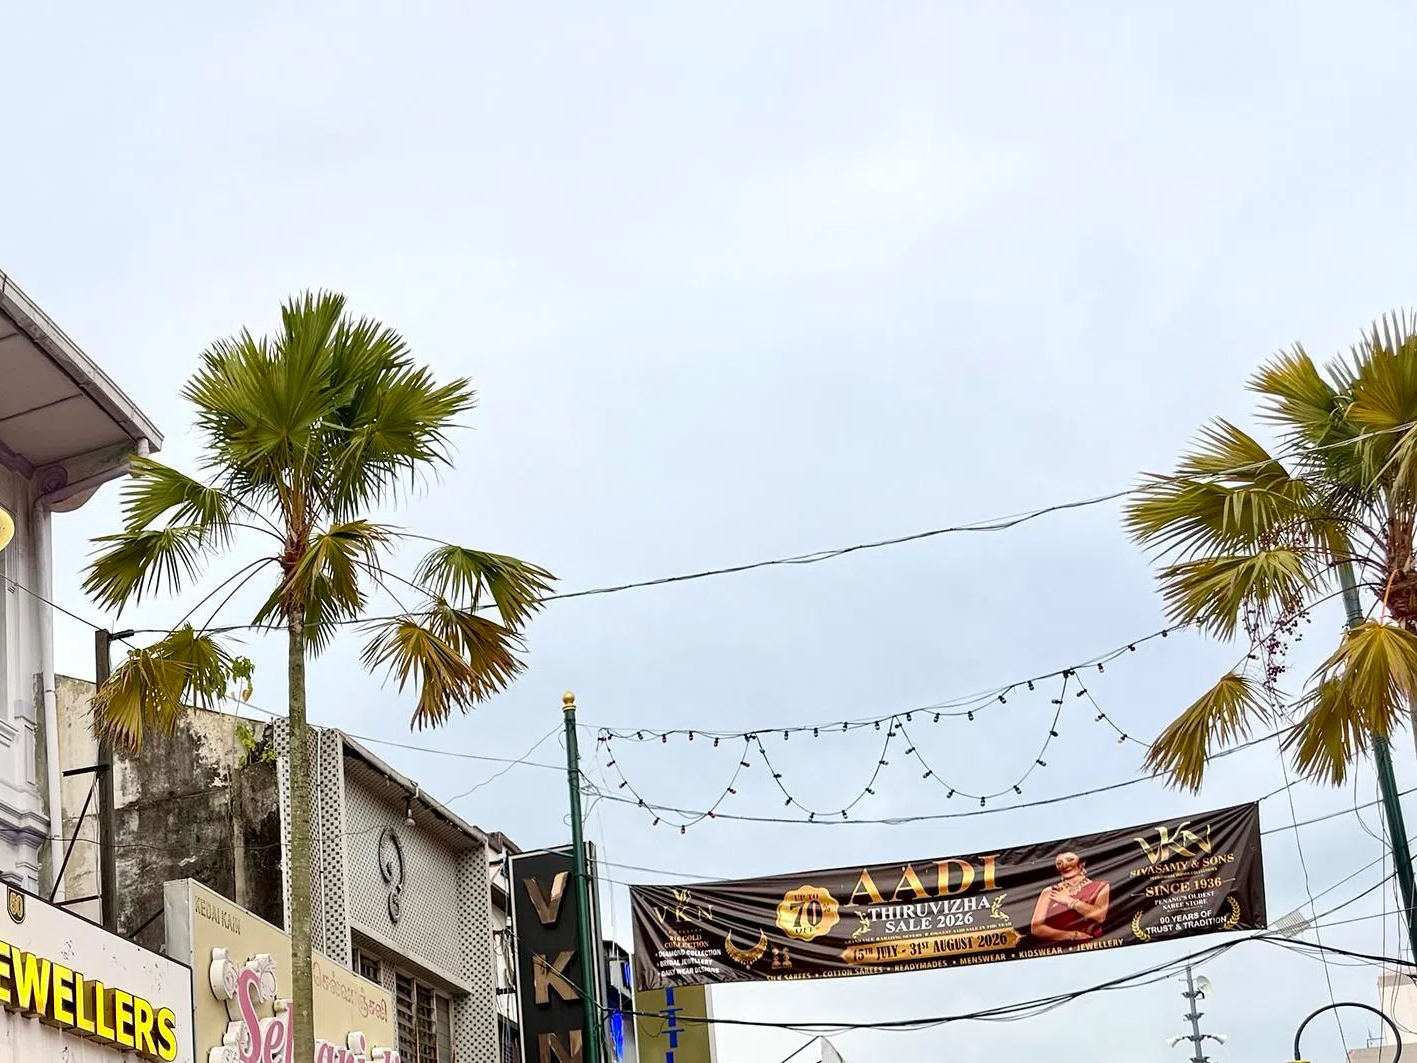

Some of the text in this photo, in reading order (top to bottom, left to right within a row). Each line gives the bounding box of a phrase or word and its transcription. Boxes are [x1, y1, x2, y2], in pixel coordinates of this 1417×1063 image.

[1129, 860, 1188, 878] SIVASAMY
[1191, 859, 1201, 869] &
[1202, 853, 1235, 867] SONS
[845, 853, 1002, 907] AADI
[1145, 876, 1222, 898] SINCE 1936
[195, 895, 221, 925] KEDAI
[868, 895, 991, 922] THIRUVIZHA
[1171, 912, 1199, 923] YEARS
[1200, 909, 1212, 918] OF
[885, 916, 932, 934] SALE
[936, 911, 974, 928] 2026
[1145, 915, 1227, 935] TRUST & TRADITION
[876, 944, 898, 961] JULY
[933, 936, 974, 954] AUGUST
[977, 933, 1008, 948] 2026
[894, 959, 948, 972] READYMADES
[959, 953, 1006, 965] MENSWEAR
[1018, 946, 1063, 959] KIDSWEAR
[1075, 937, 1124, 952] JEWELLERY
